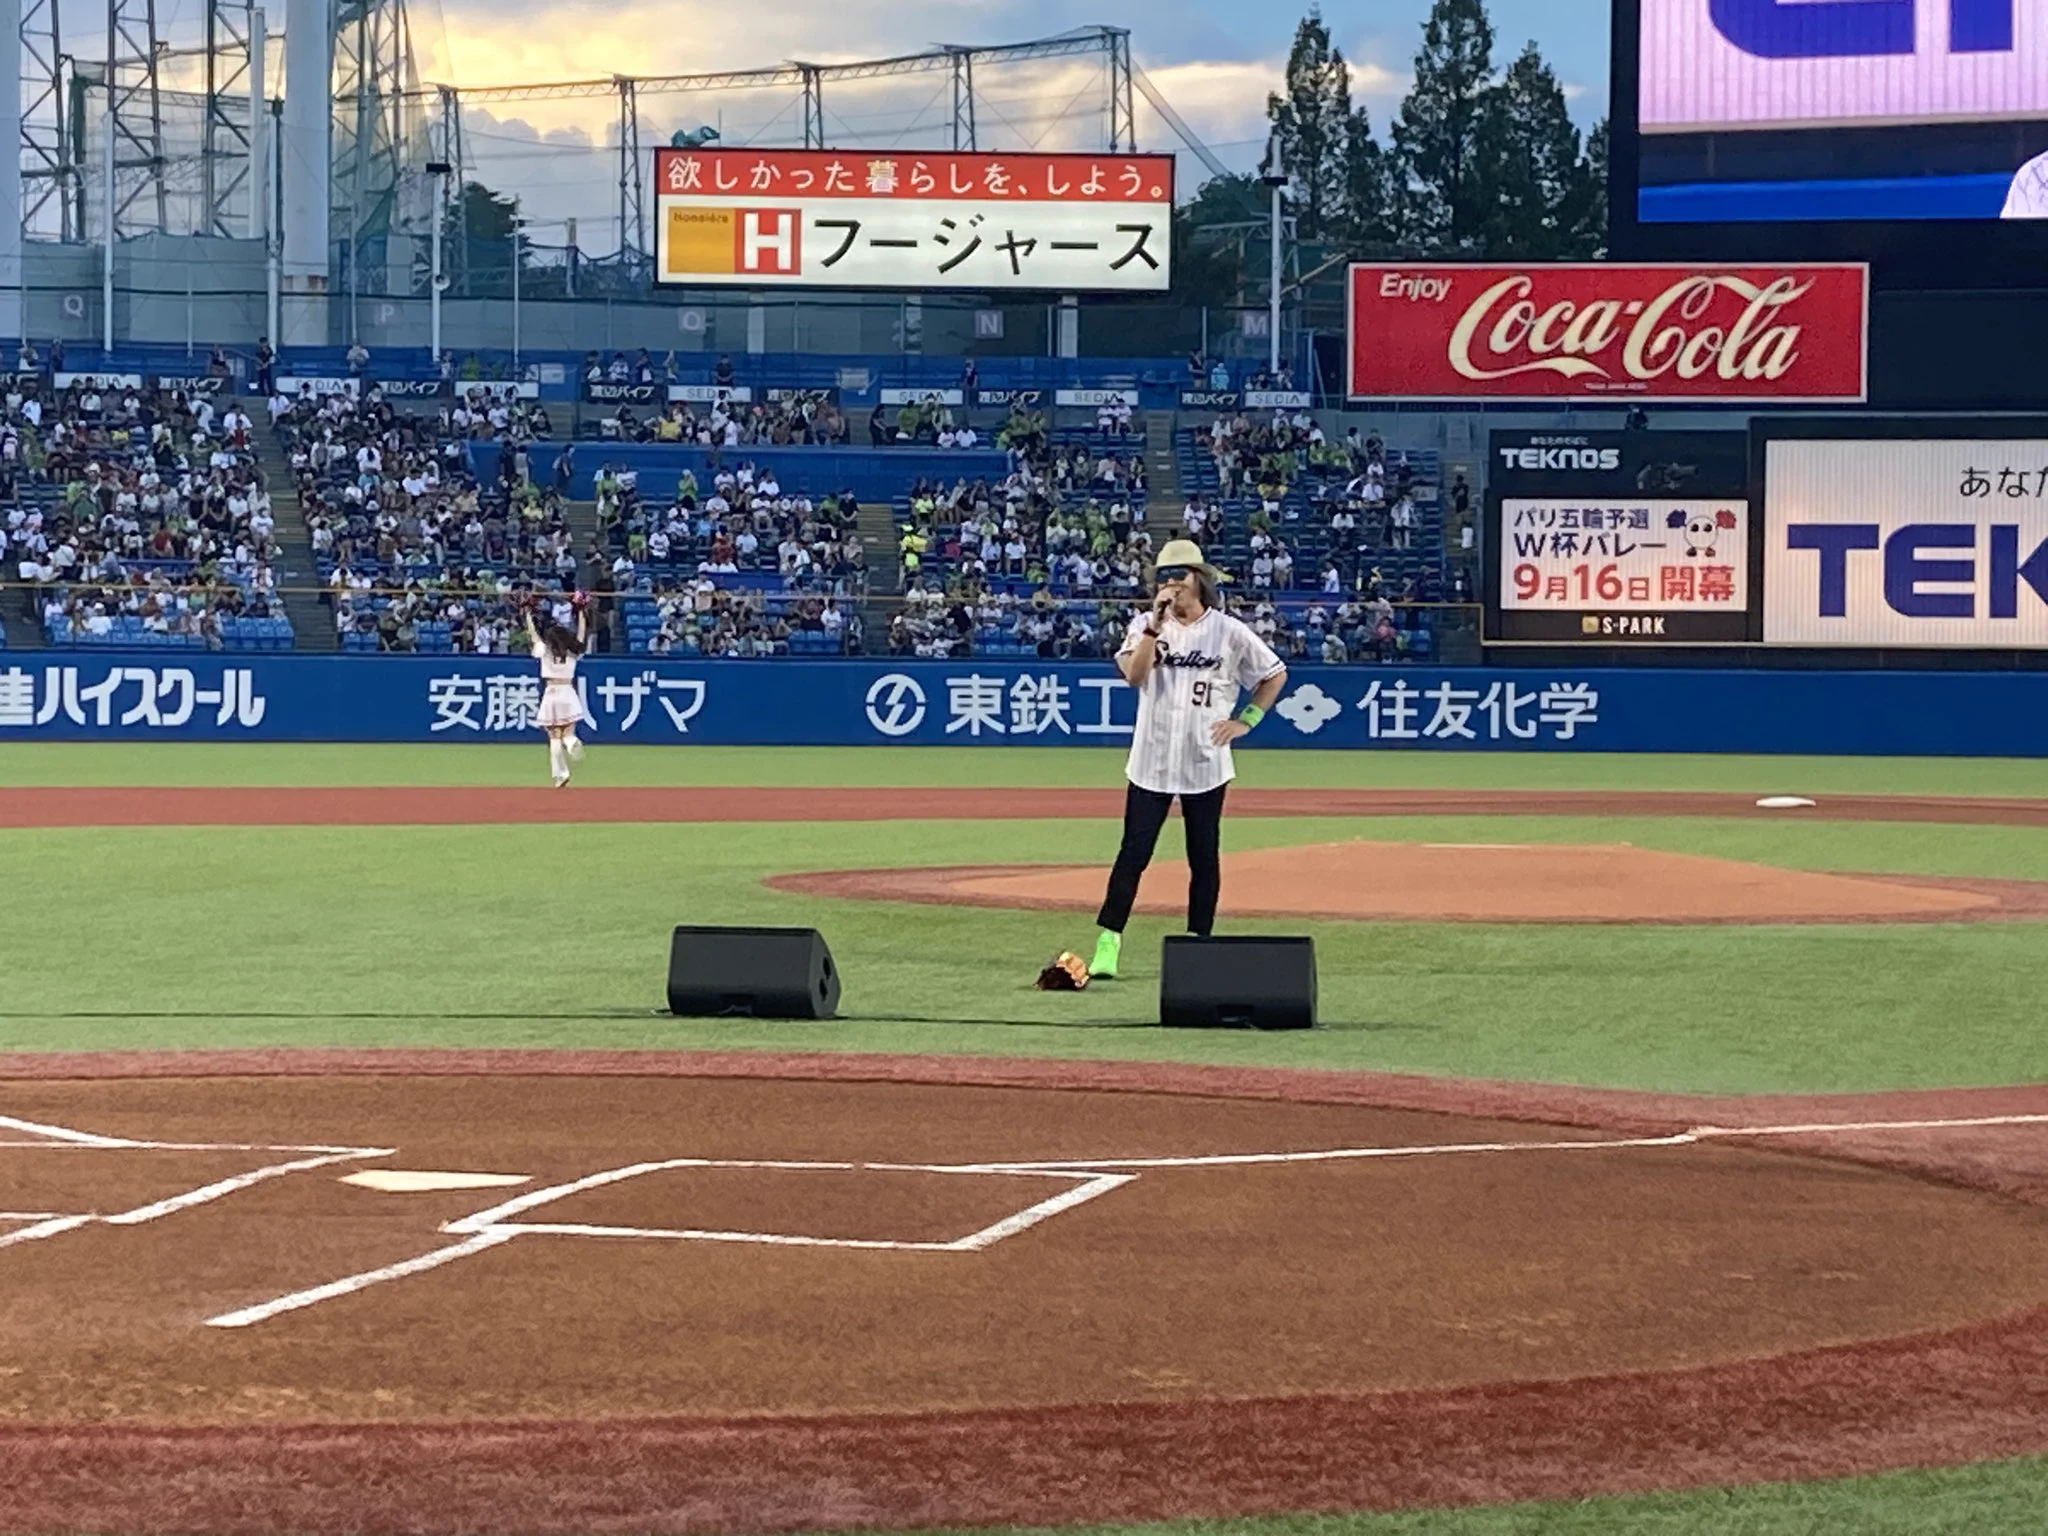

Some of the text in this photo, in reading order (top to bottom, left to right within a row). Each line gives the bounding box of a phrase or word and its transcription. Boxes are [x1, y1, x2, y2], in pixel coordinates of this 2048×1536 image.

[668, 156, 1164, 199] 欲しかった暮らしを、しよう。
[744, 213, 792, 270] H
[814, 212, 1161, 275] フージャース
[1380, 273, 1453, 301] Enjoy
[63, 294, 83, 318] Q
[381, 303, 396, 324] P
[981, 314, 997, 334] N
[1243, 315, 1270, 336] M
[1447, 275, 1817, 380] Coca-Cola
[1500, 448, 1619, 469] TEKNOS
[1514, 532, 1667, 558] W杯バレー
[1787, 523, 2048, 618] TEK
[1191, 680, 1213, 708] 91
[1356, 679, 1598, 739] 住友化学
